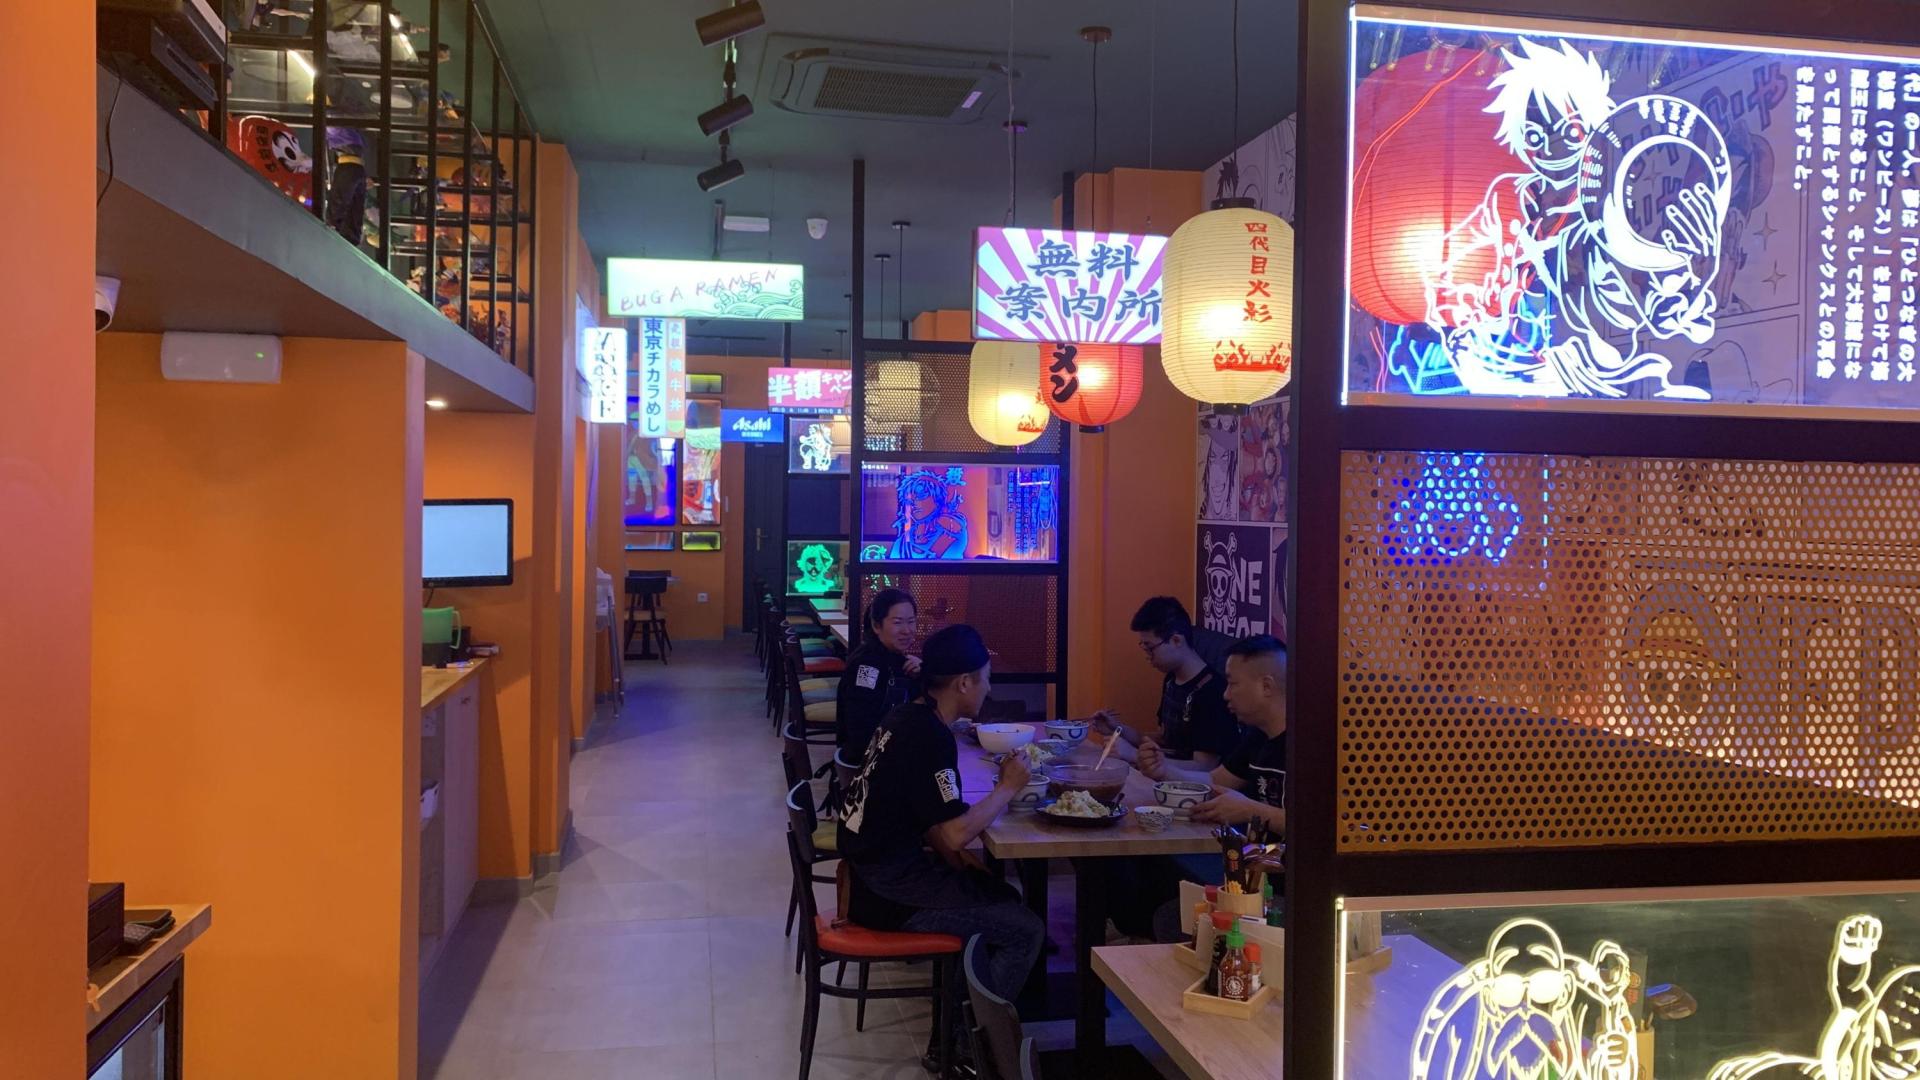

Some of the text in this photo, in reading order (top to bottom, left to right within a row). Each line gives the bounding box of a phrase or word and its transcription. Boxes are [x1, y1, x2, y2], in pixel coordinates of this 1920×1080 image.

[1027, 239, 1139, 280] 無料
[1242, 222, 1273, 323] 四代目火影
[620, 267, 780, 313] BUGA RAMEN
[997, 283, 1162, 327] 案内所
[644, 318, 662, 432] 東京チカラめし
[768, 370, 822, 403] 半額
[1049, 343, 1078, 403] メン
[732, 416, 772, 431] Asahi
